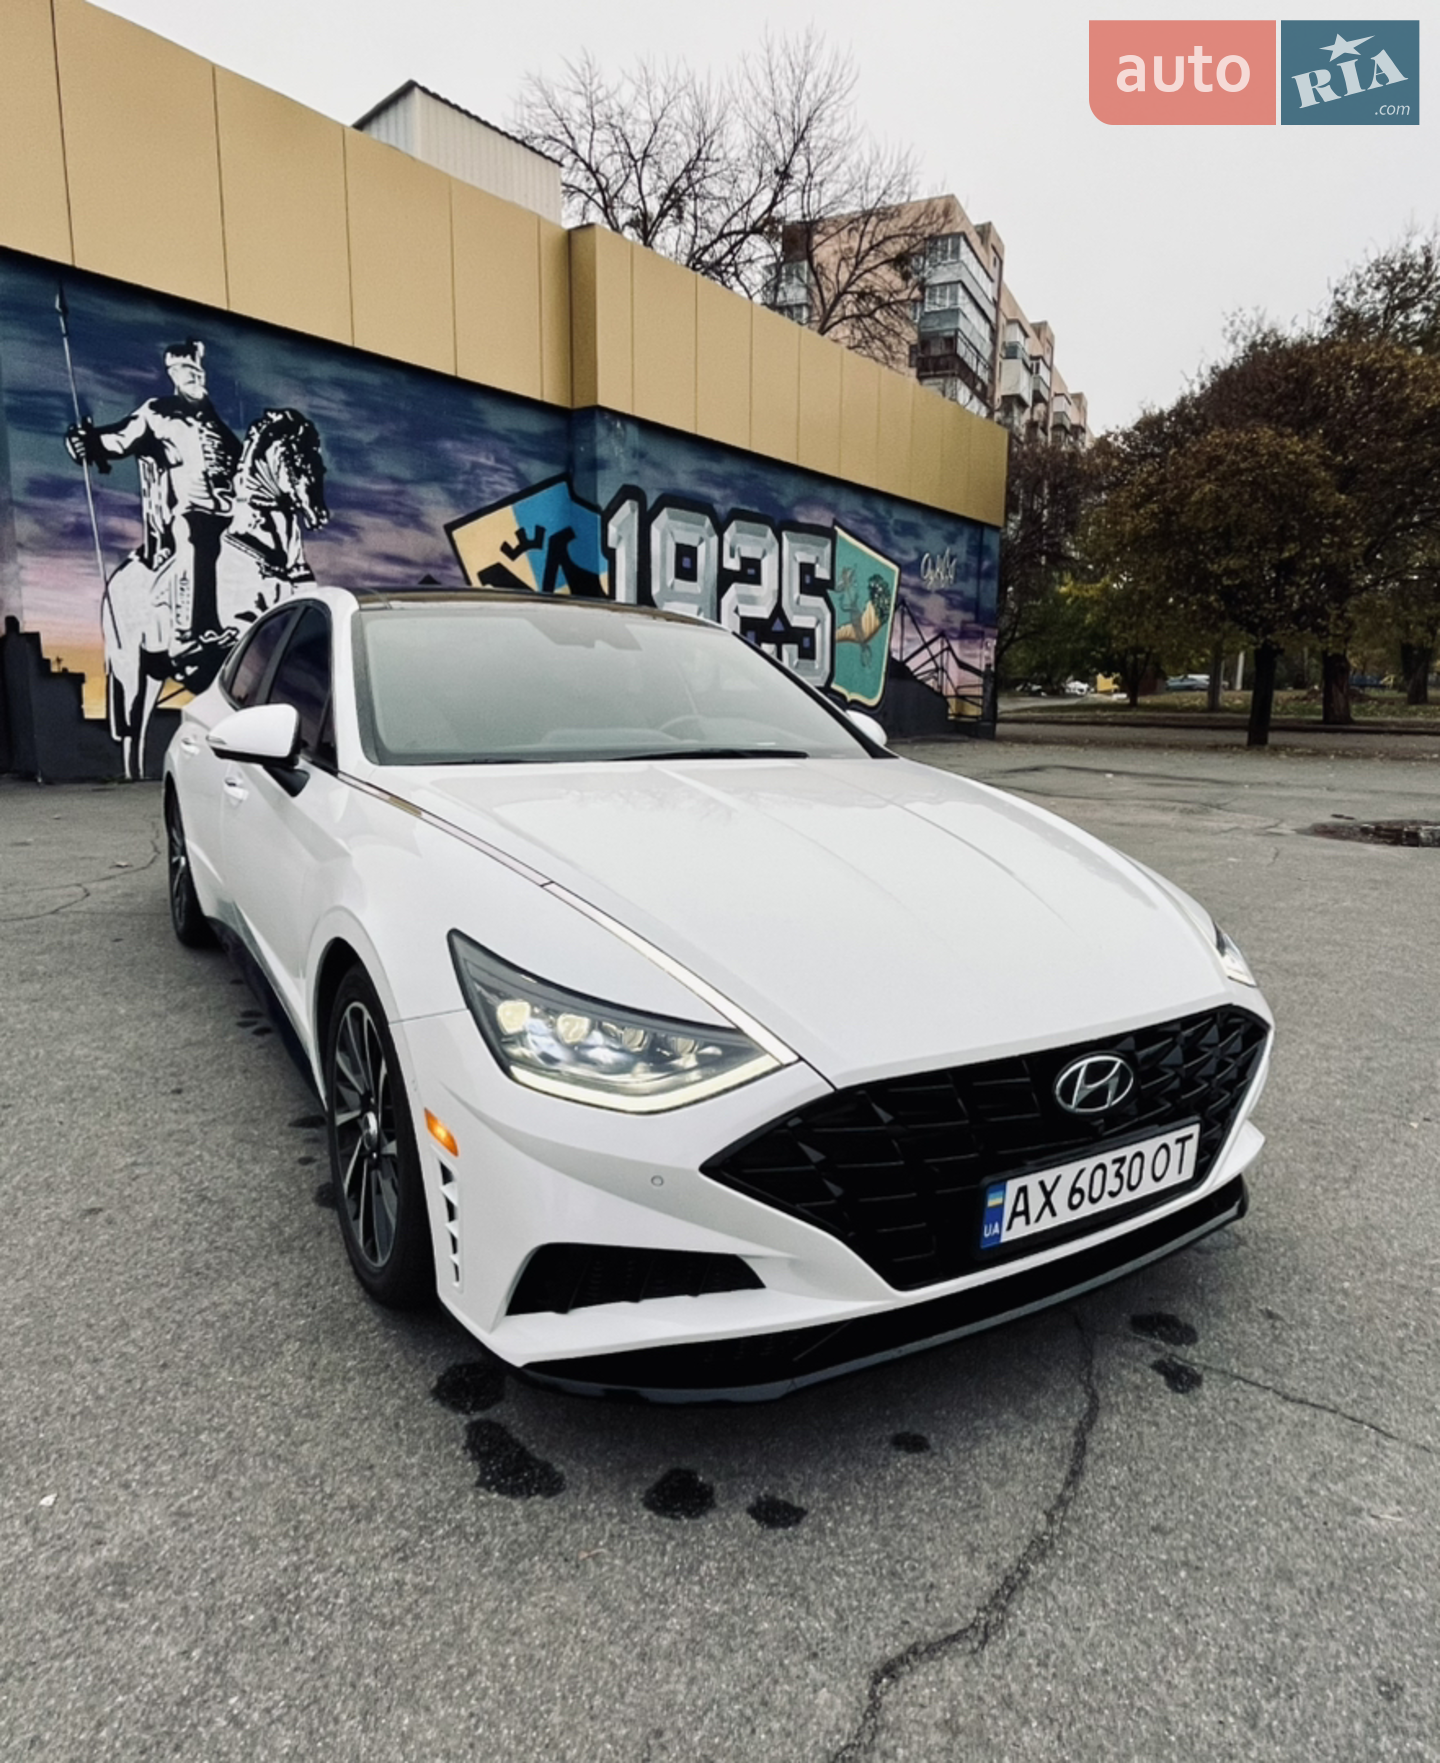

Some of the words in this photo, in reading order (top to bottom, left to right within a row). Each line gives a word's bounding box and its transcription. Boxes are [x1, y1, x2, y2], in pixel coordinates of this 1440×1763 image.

[607, 497, 832, 688] 1925
[983, 1221, 1000, 1239] UA
[1005, 1174, 1062, 1232] AX
[1067, 1151, 1145, 1211] 6030
[1151, 1133, 1194, 1183] OT
